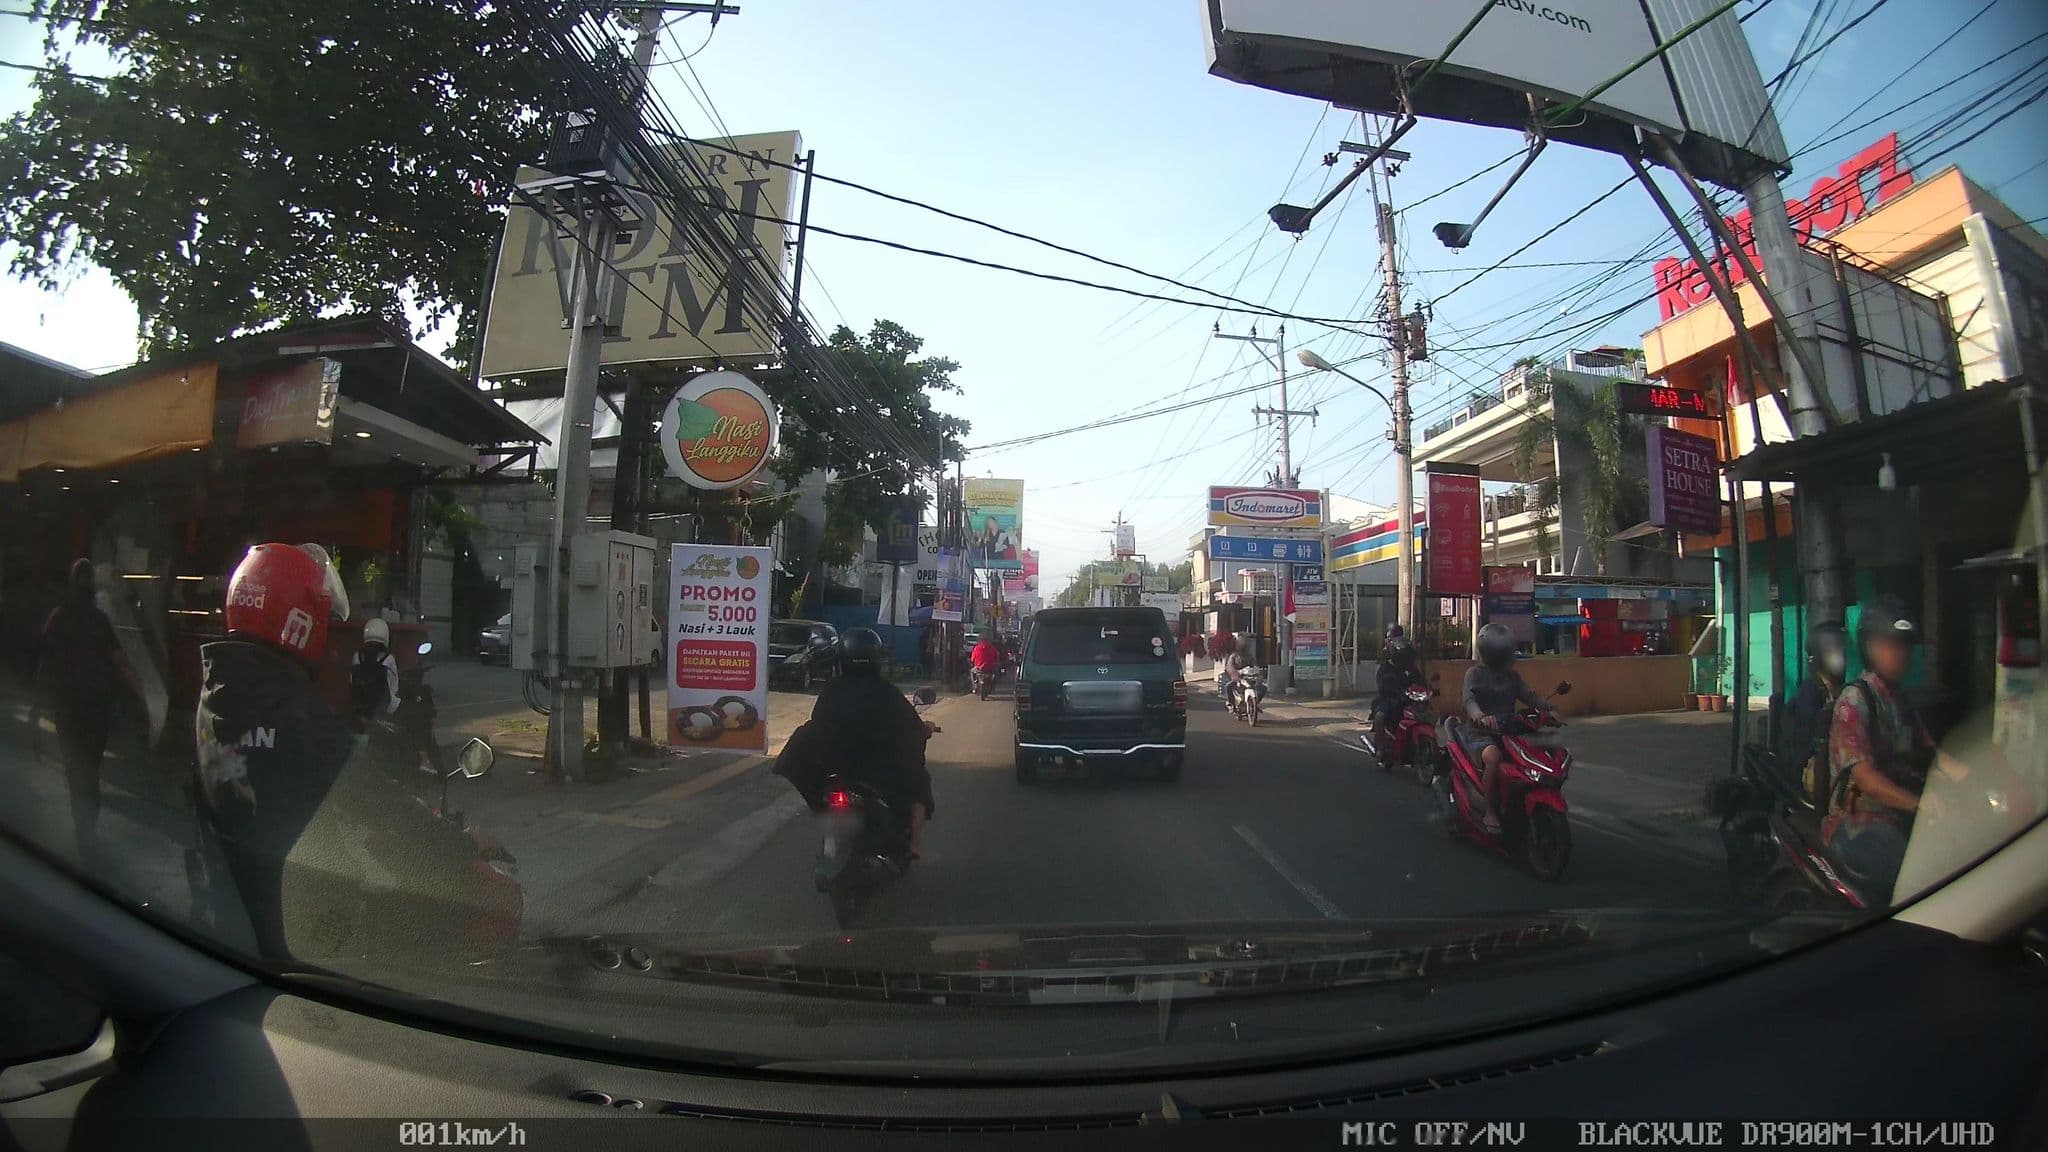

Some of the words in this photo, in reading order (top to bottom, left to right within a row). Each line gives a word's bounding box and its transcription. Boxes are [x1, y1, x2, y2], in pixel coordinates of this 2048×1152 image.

[712, 415, 763, 442] Nasi
[686, 437, 760, 463] Langgiku
[1665, 446, 1711, 474] SETRA
[1667, 469, 1712, 497] HOUSE
[1231, 499, 1300, 514] Indomaret
[680, 585, 756, 602] PROMO
[708, 605, 757, 622] 5.000
[678, 623, 706, 634] Nasi
[716, 625, 724, 635] 3
[726, 625, 756, 636] Lauk
[719, 658, 751, 668] GRATIS
